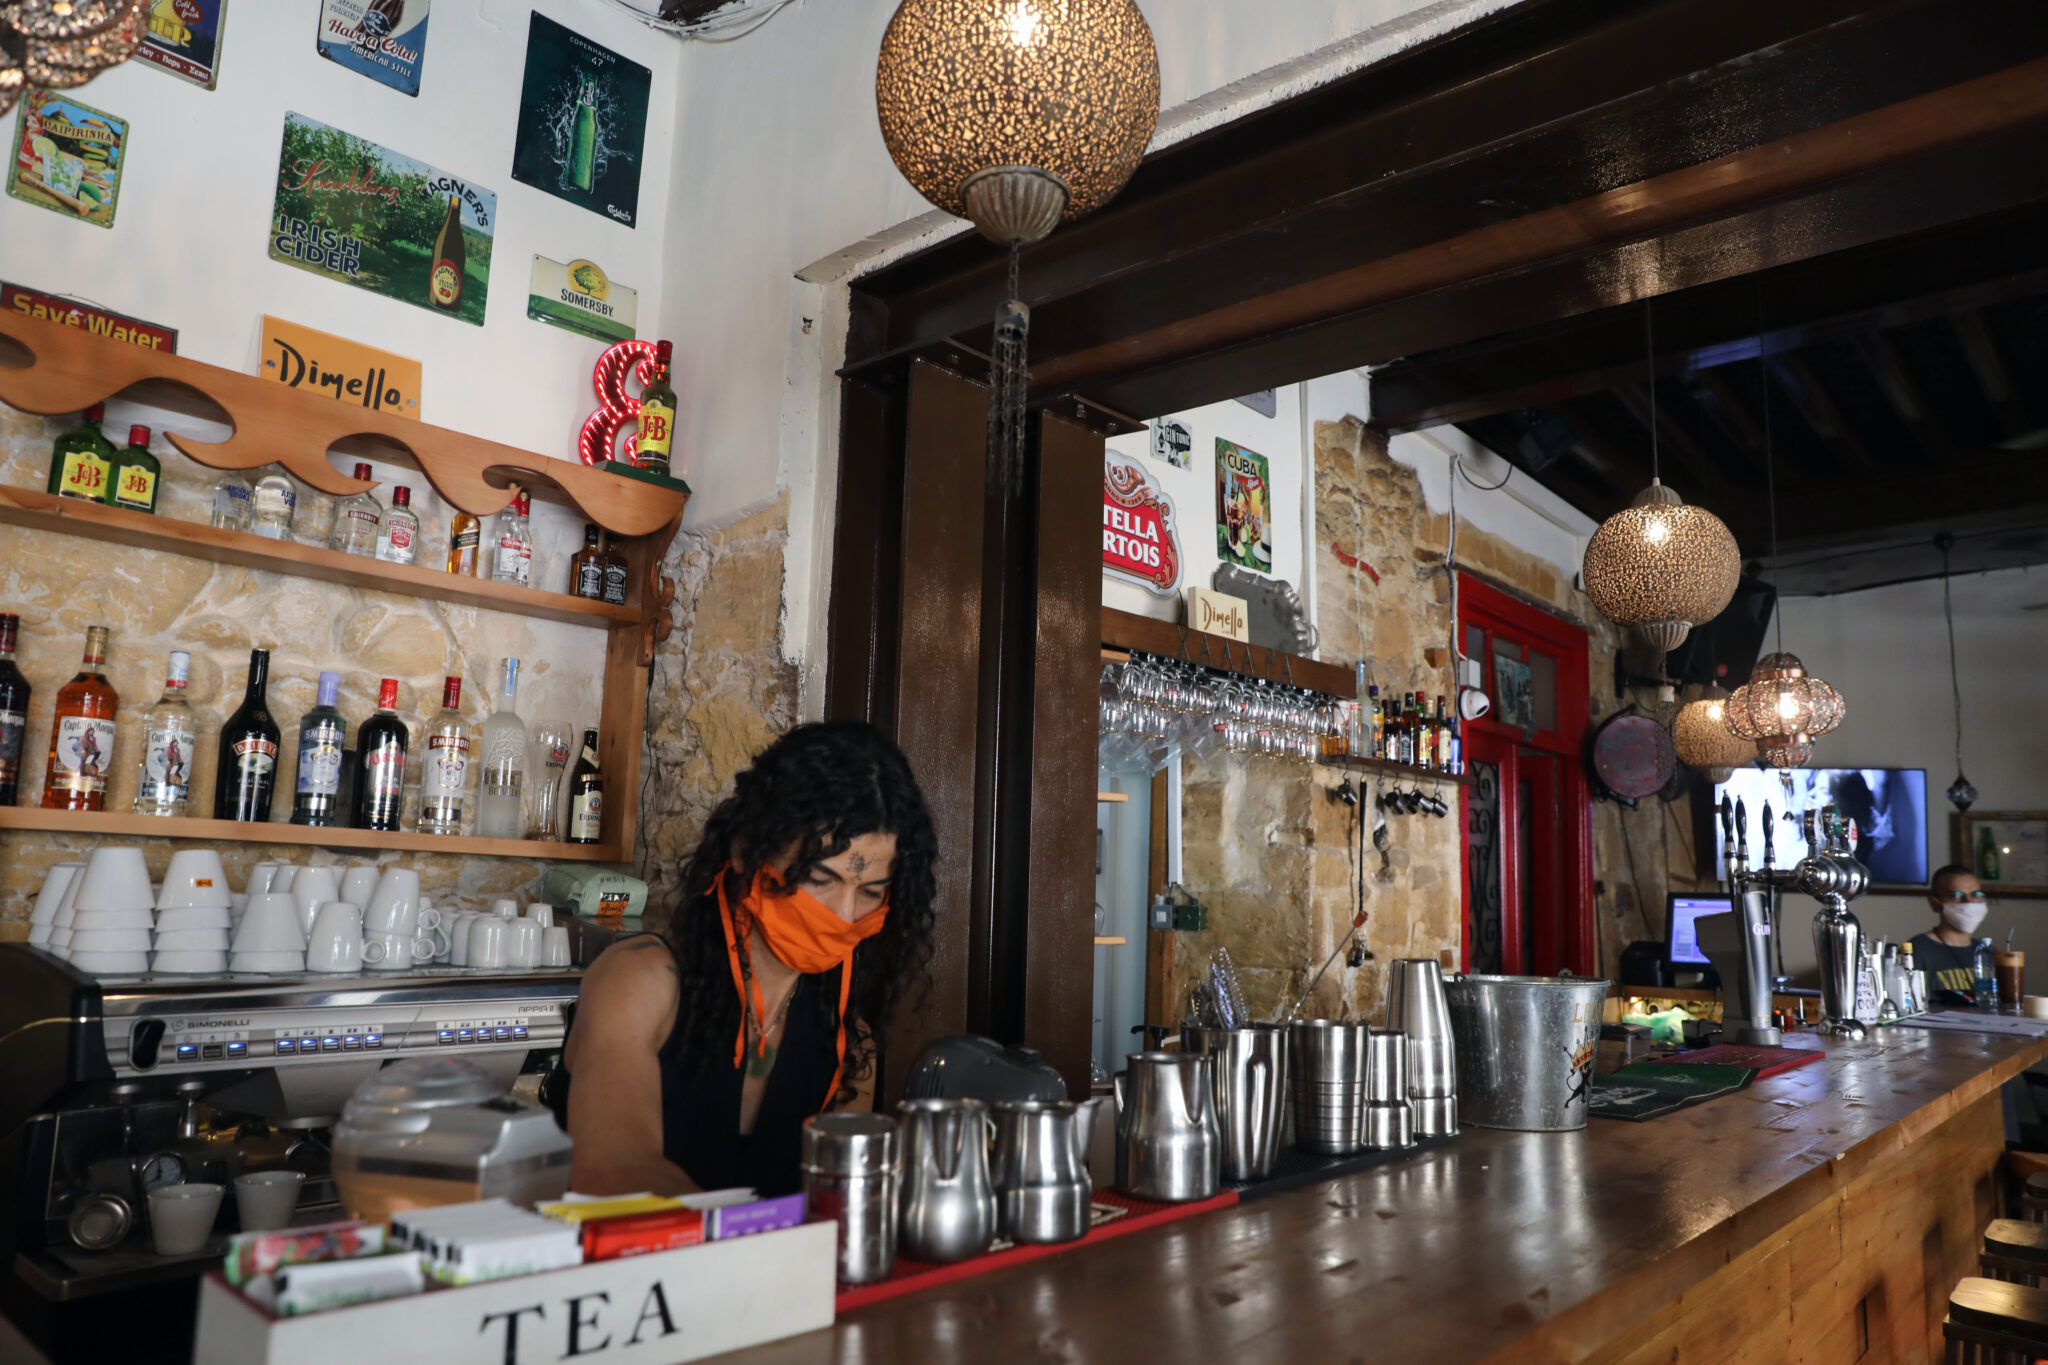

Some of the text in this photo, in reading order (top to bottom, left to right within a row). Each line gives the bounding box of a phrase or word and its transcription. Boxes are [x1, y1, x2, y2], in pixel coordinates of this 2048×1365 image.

[328, 19, 366, 44] Have
[366, 37, 379, 50] a
[380, 37, 418, 64] Cola!
[569, 36, 616, 64] COPENHAGEN
[350, 45, 412, 78] AMERICAN STYLE
[43, 120, 112, 142] CAIPIRINHA
[283, 158, 400, 208] Sparkling
[279, 213, 362, 259] IRISH
[274, 235, 361, 279] CIDER
[560, 288, 614, 318] SOMERSBY
[13, 293, 163, 351] Save Water
[272, 337, 402, 411] Dimello
[639, 415, 667, 441] J&B
[70, 463, 102, 489] J&B
[1228, 454, 1258, 477] CUBA
[124, 474, 148, 494] J&B
[1103, 504, 1160, 544] TELLA
[1103, 529, 1160, 568] RTOIS
[1200, 596, 1244, 639] Dimello
[64, 720, 92, 732] Captain
[1936, 966, 1976, 991] NIRV
[187, 1019, 250, 1029] SIMONELLI
[478, 1279, 683, 1365] TEA
